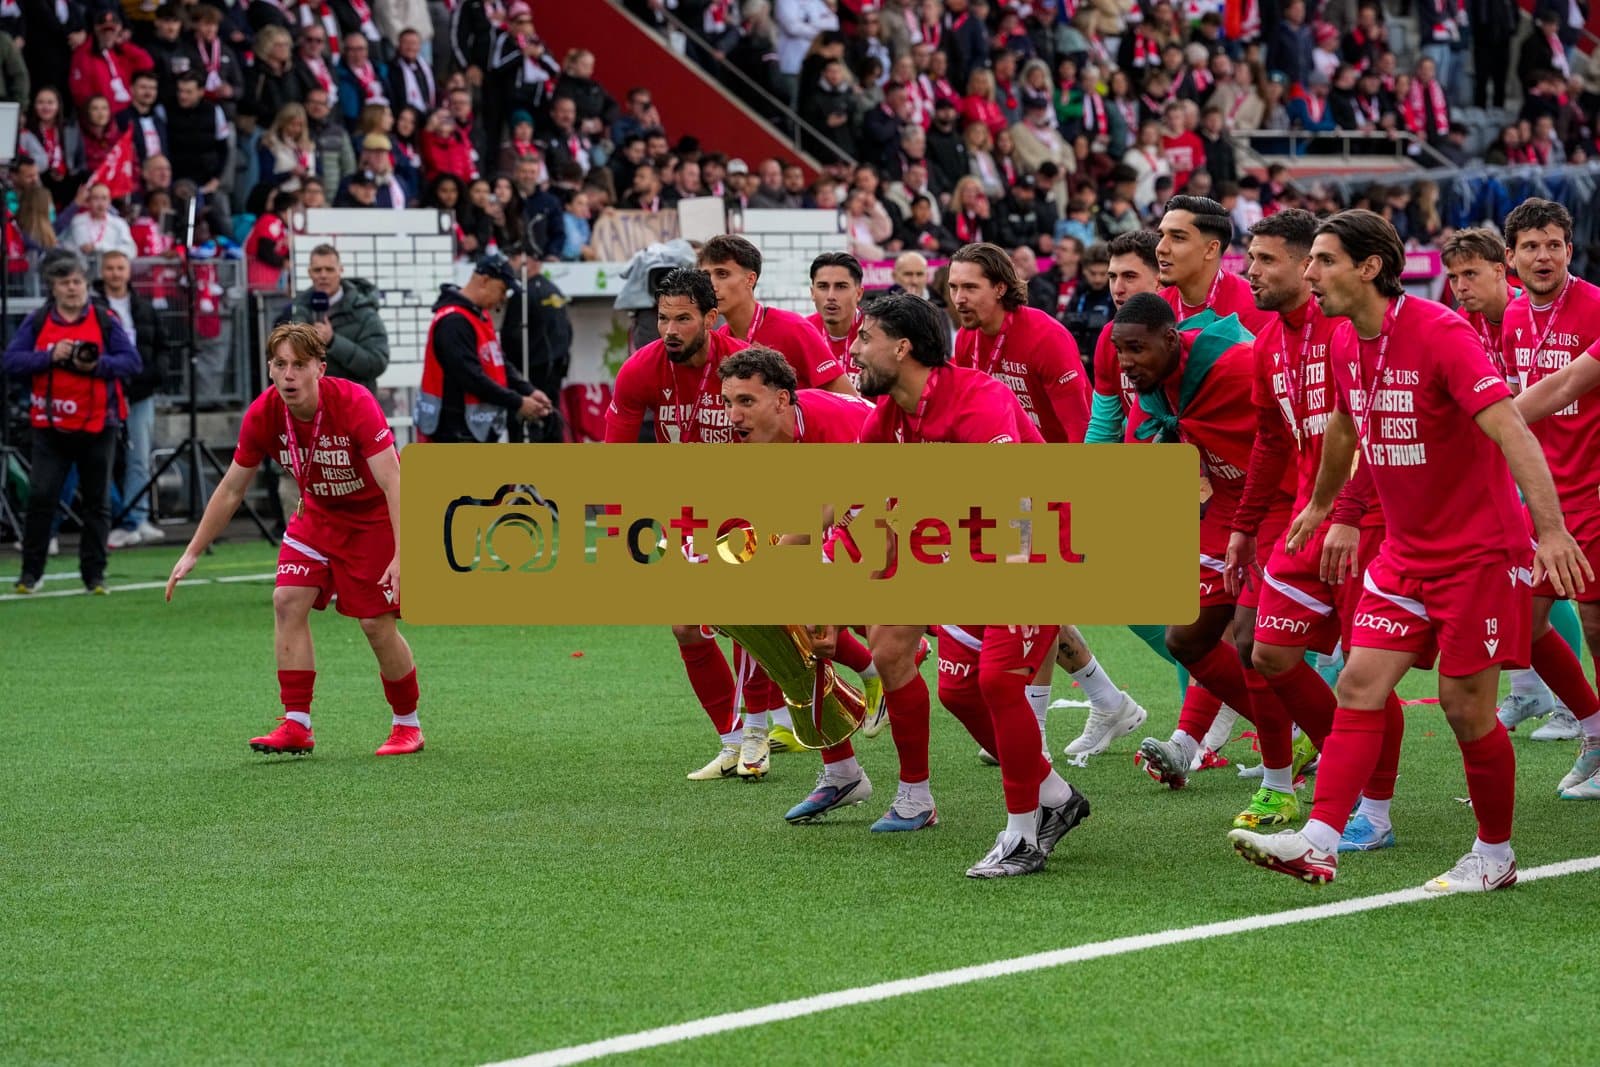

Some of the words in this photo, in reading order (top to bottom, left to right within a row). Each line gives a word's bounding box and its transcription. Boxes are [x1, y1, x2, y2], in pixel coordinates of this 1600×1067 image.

[1558, 332, 1580, 347] UBS
[1312, 343, 1326, 358] UB
[1396, 369, 1420, 386] UBS
[1381, 417, 1418, 440] HEISST
[1371, 444, 1385, 467] FC
[1386, 442, 1427, 467] THUN!
[321, 465, 357, 481] HEISST
[313, 482, 329, 496] FC
[1257, 613, 1311, 635] UXAN
[1485, 617, 1498, 636] 19
